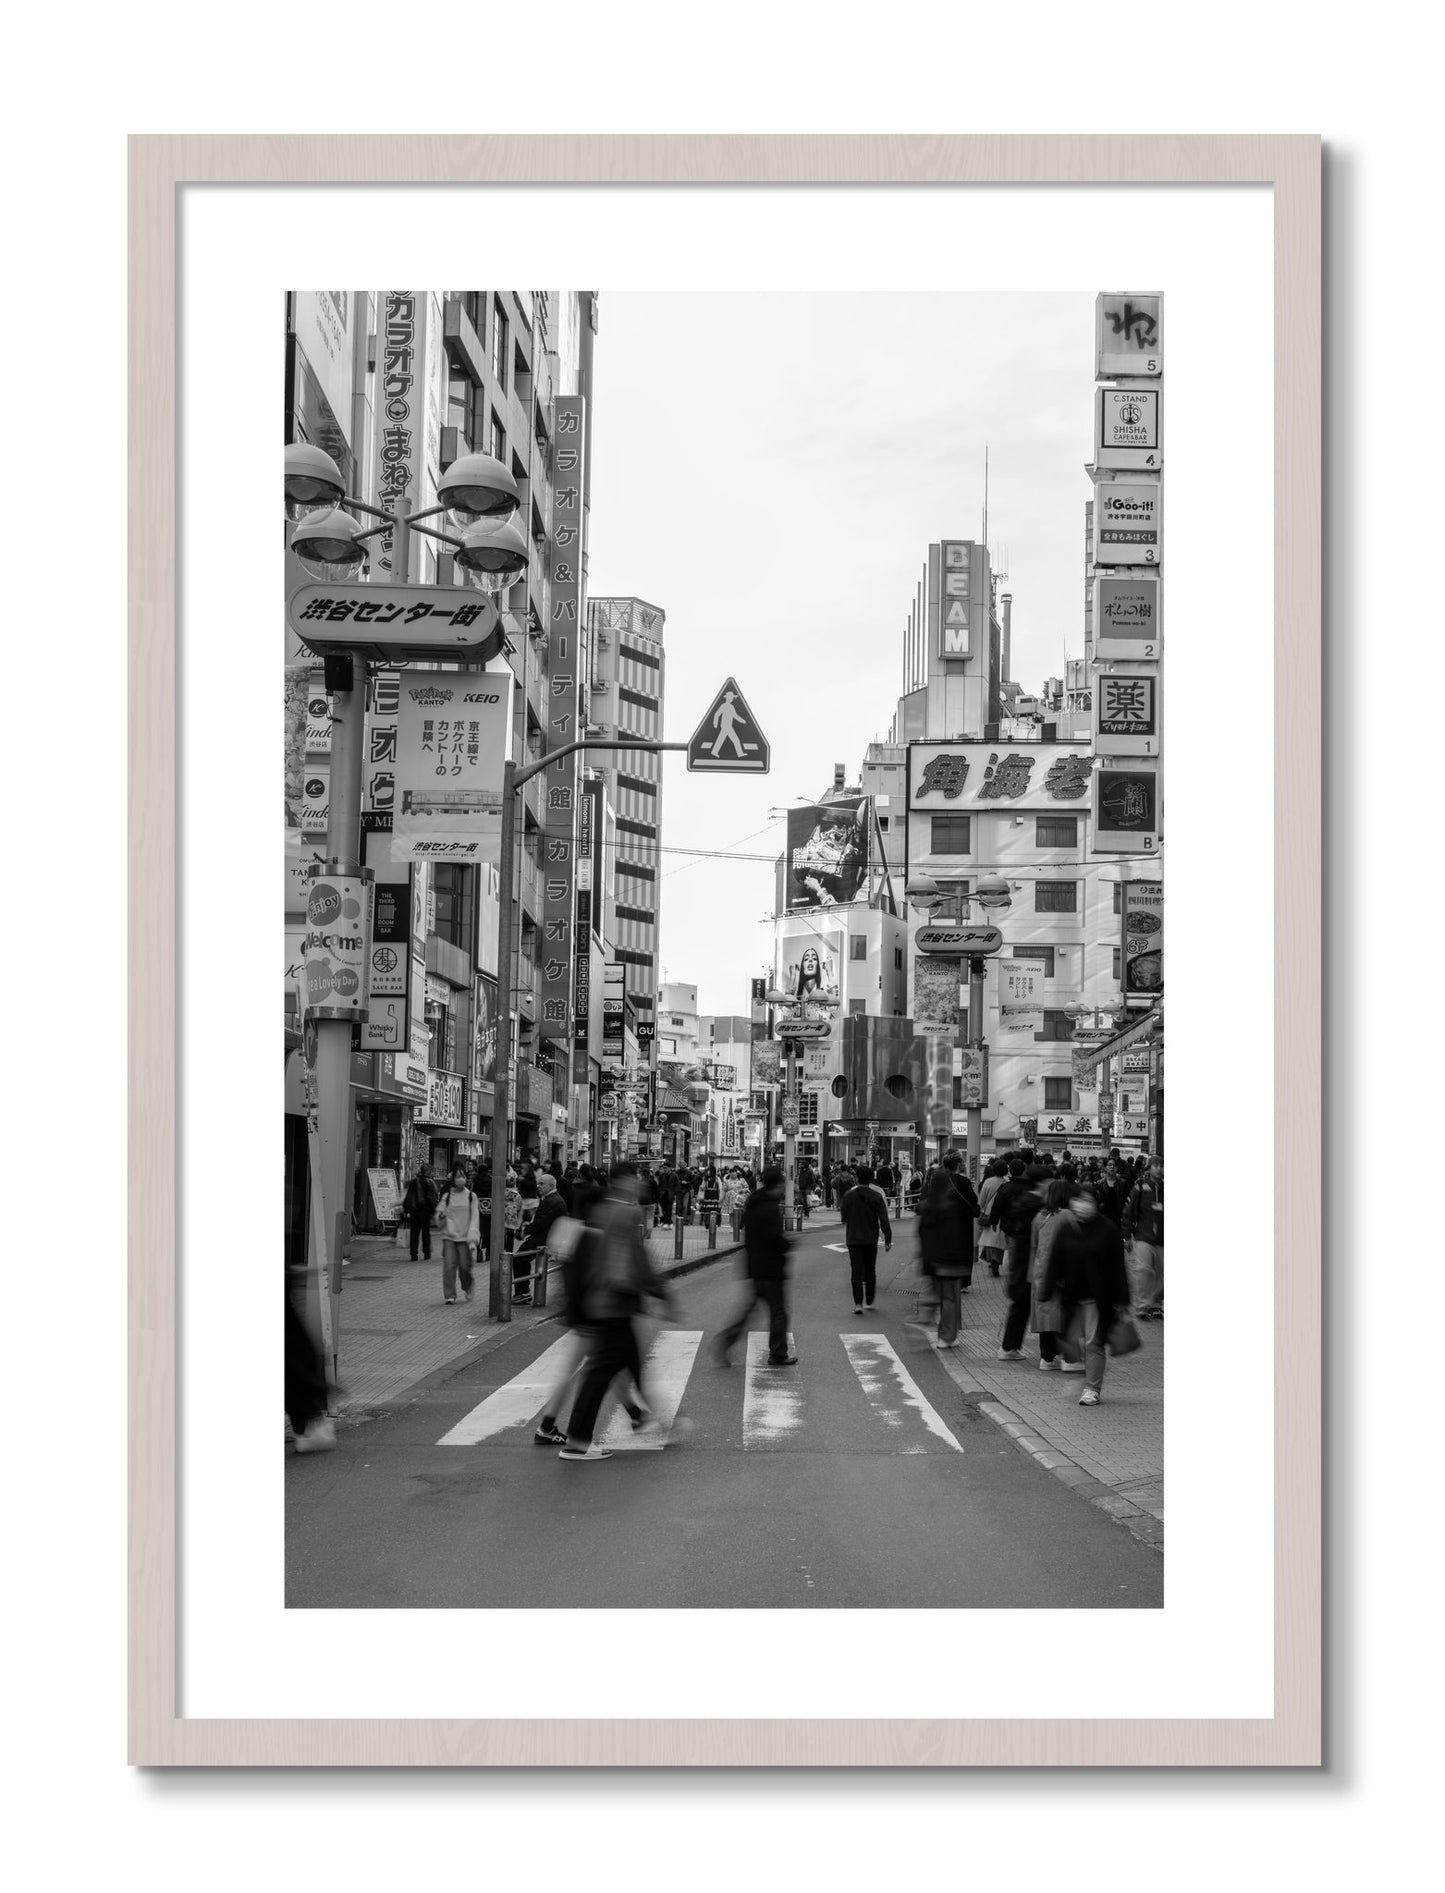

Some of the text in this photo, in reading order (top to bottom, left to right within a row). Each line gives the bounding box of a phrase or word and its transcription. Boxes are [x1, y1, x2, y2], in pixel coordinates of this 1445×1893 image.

[384, 297, 415, 400] カラオケ
[1147, 359, 1156, 371] 5
[1113, 425, 1148, 434] SHISHA
[1146, 454, 1156, 466] 4
[1113, 498, 1154, 512] Goo-it!
[1103, 532, 1155, 542] 全身もみほぐし
[1145, 549, 1155, 562] 3
[945, 544, 968, 653] BEAM
[298, 598, 485, 627] 渋谷センター街
[1144, 645, 1154, 657] 2
[463, 693, 500, 704] KEIO
[1106, 681, 1145, 720] 薬
[422, 719, 434, 752] 冒険へ
[435, 720, 449, 776] カントーの
[466, 720, 480, 766] 京王線で
[1144, 741, 1151, 753] 1
[915, 754, 1093, 799] 角海老
[1103, 782, 1148, 820] 一蘭
[582, 797, 591, 825] kimono
[411, 841, 479, 852] 渋谷センター街
[1143, 837, 1153, 849] B
[306, 931, 364, 951] Welcome
[920, 932, 997, 943] 渋谷センター街
[1127, 940, 1149, 954] 6F
[369, 1024, 394, 1034] Whisky
[639, 1026, 654, 1035] GU
[1047, 1116, 1092, 1133] 兆楽
